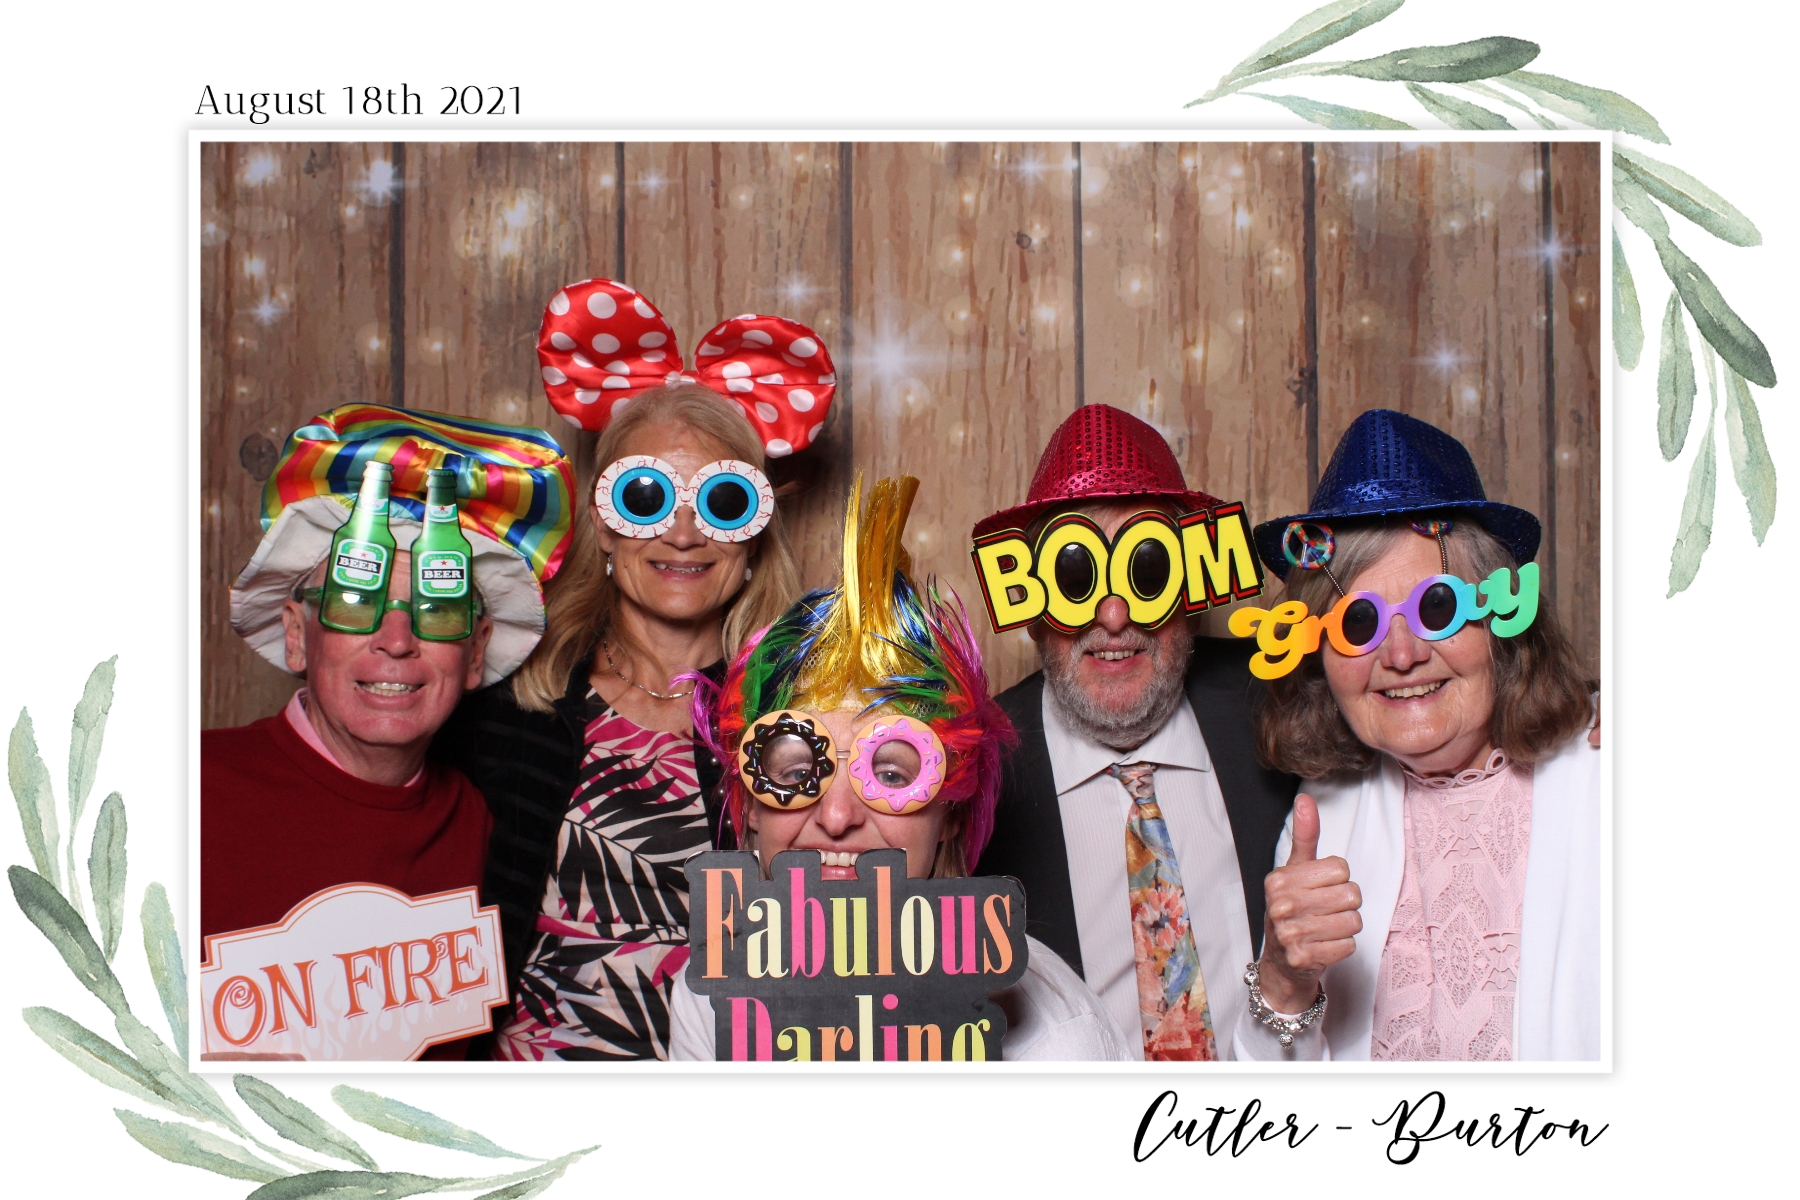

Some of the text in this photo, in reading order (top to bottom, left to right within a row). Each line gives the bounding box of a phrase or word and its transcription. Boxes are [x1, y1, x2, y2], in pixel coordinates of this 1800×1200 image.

[338, 556, 378, 573] BEER
[423, 569, 462, 579] BEER
[975, 511, 1262, 629] BOOM
[700, 865, 1014, 979] Fabulous
[212, 924, 488, 1047] ON FIRE
